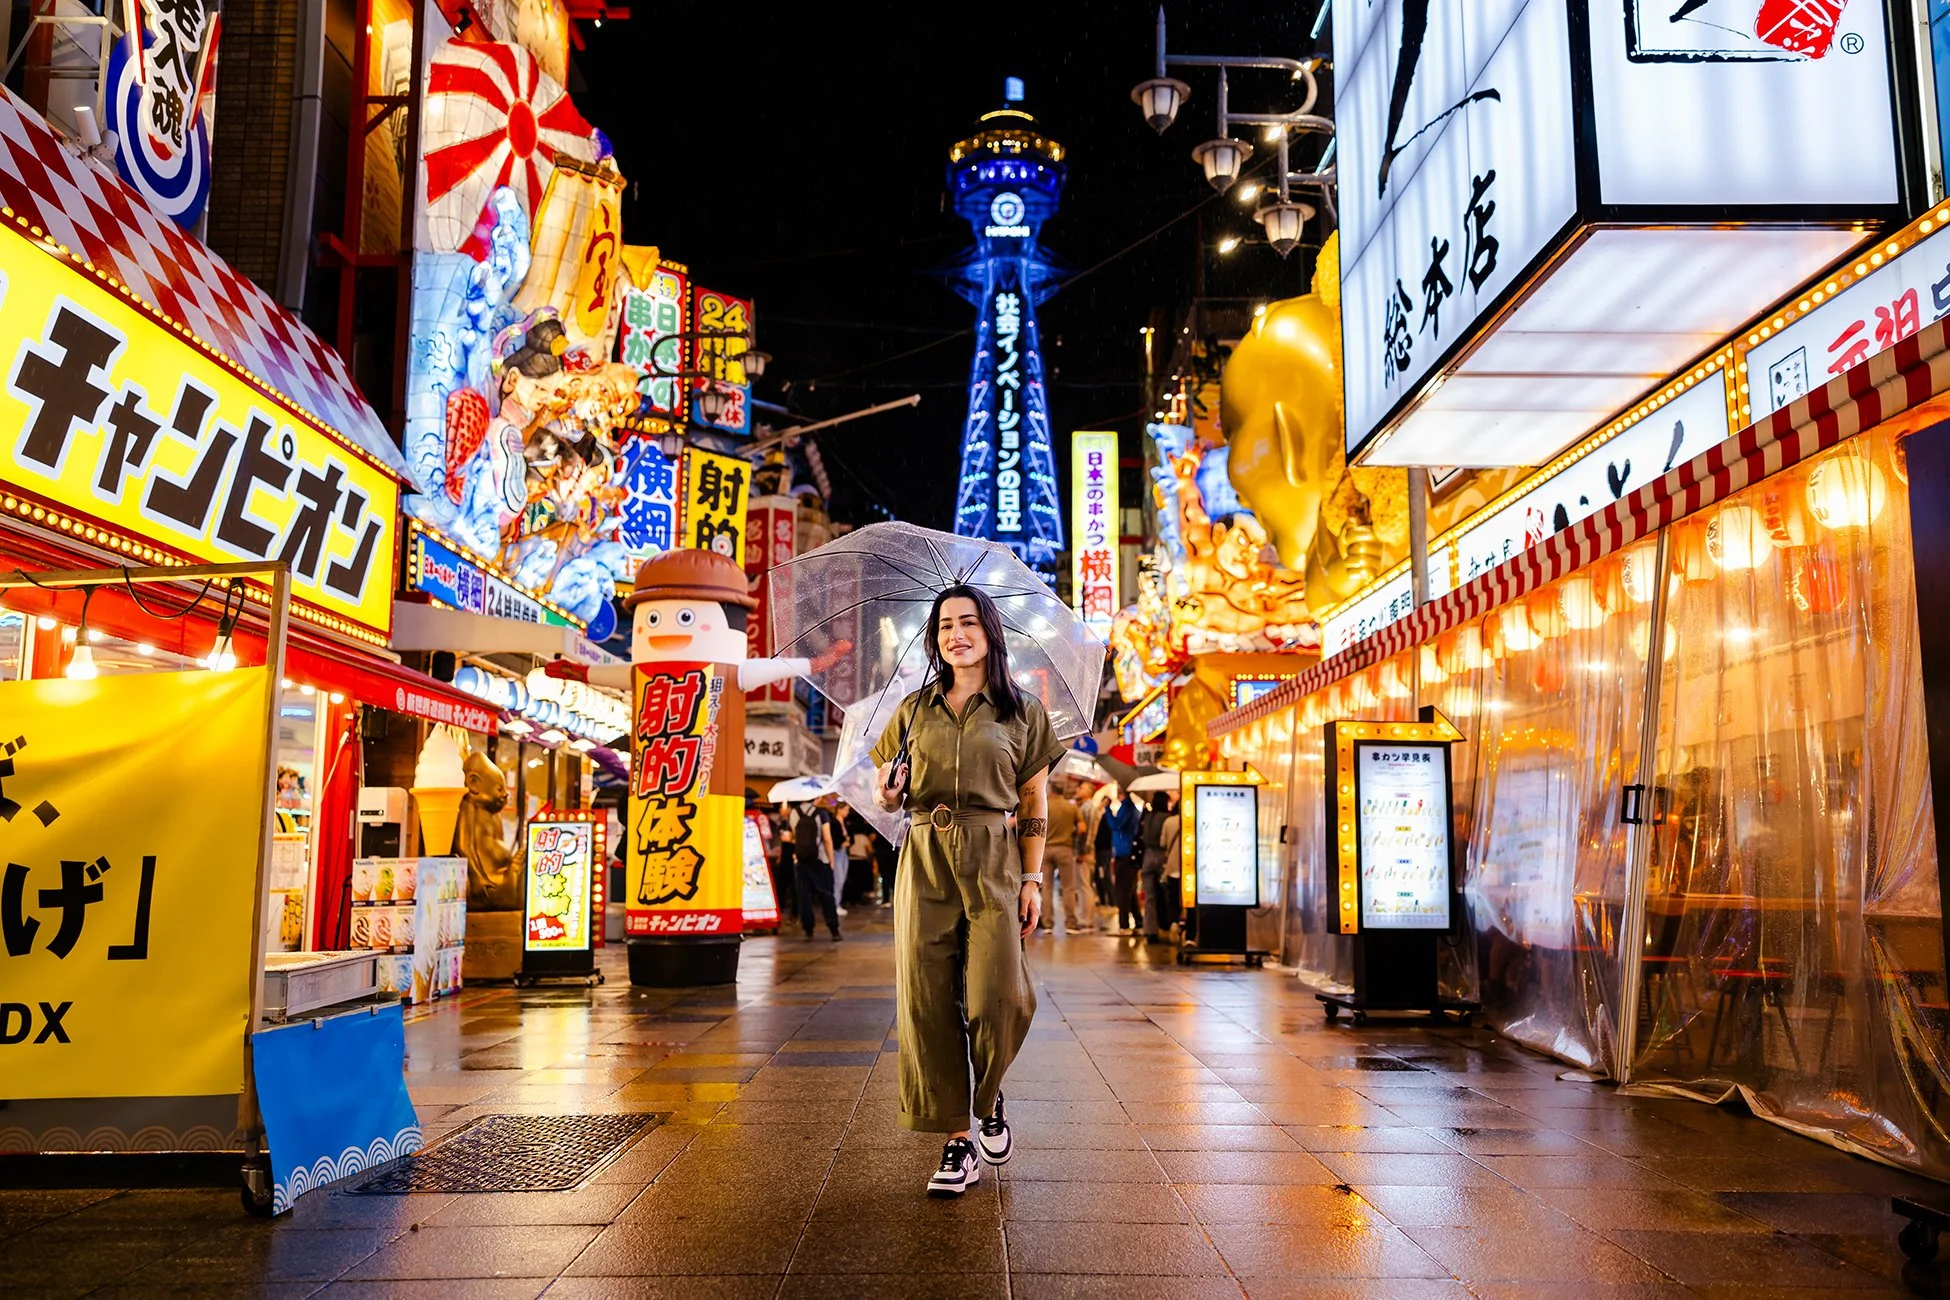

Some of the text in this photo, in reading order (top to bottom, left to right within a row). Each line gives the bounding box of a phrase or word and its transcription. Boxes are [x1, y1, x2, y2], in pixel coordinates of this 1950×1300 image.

[15, 306, 382, 599] チャンピオン
[995, 293, 1021, 532] 社会イノベーションの日立
[1087, 452, 1105, 546] 日本一の串かつ
[637, 671, 706, 905] 射的体験
